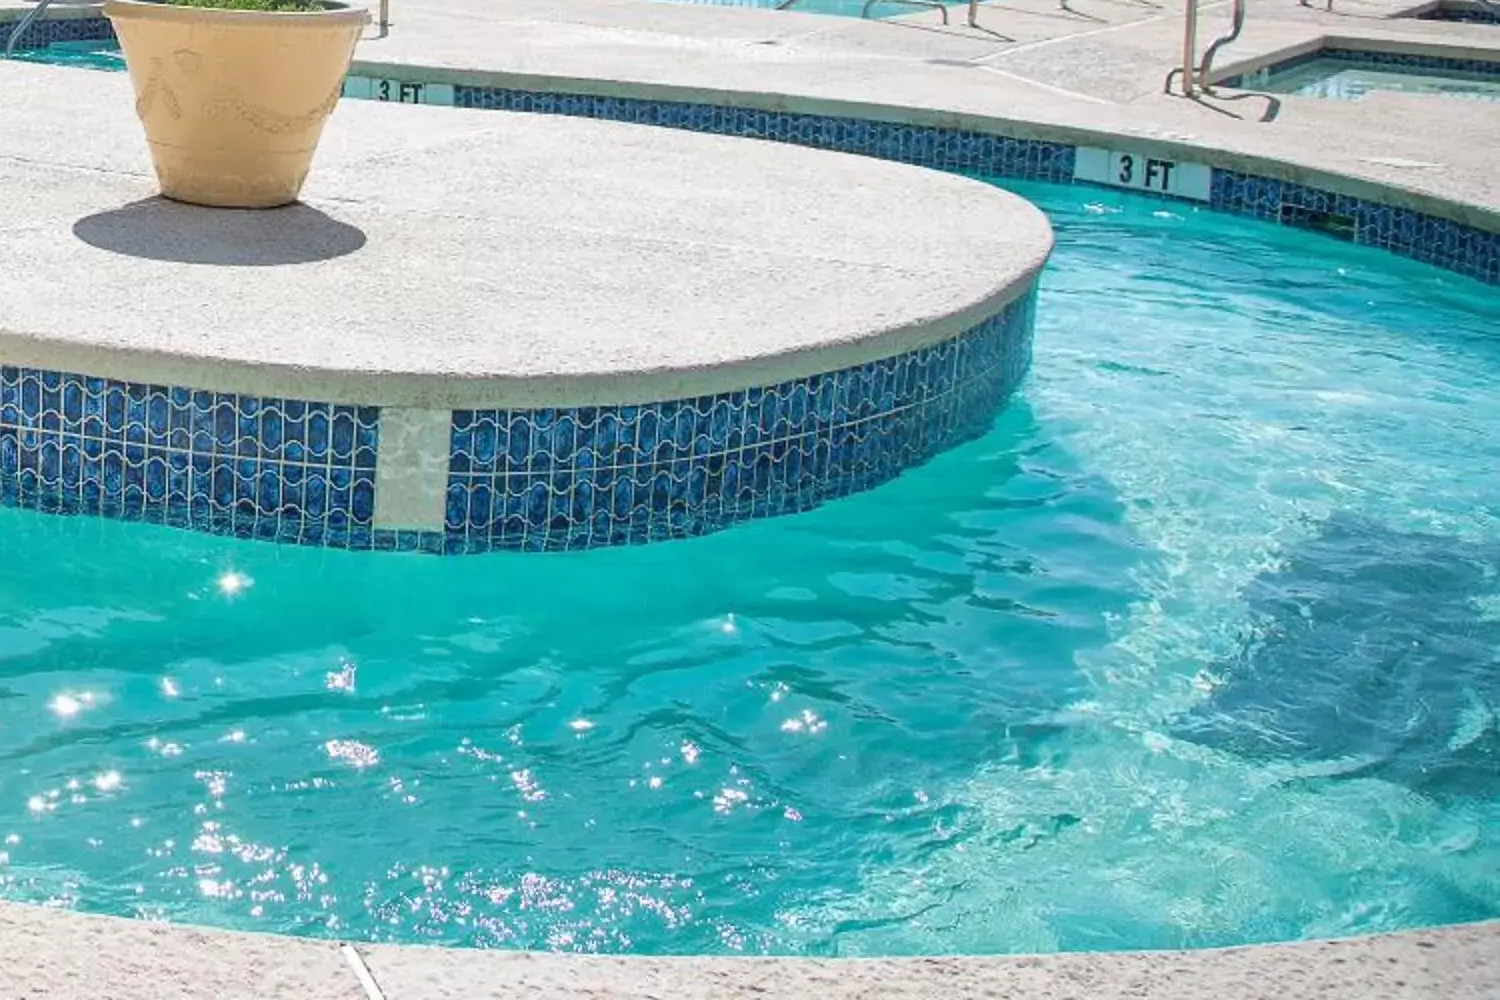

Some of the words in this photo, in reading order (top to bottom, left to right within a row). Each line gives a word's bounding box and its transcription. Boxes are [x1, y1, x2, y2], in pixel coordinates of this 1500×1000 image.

[379, 80, 390, 102] 3
[401, 83, 422, 104] FT
[1119, 155, 1133, 183] 3
[1145, 158, 1175, 190] FT
